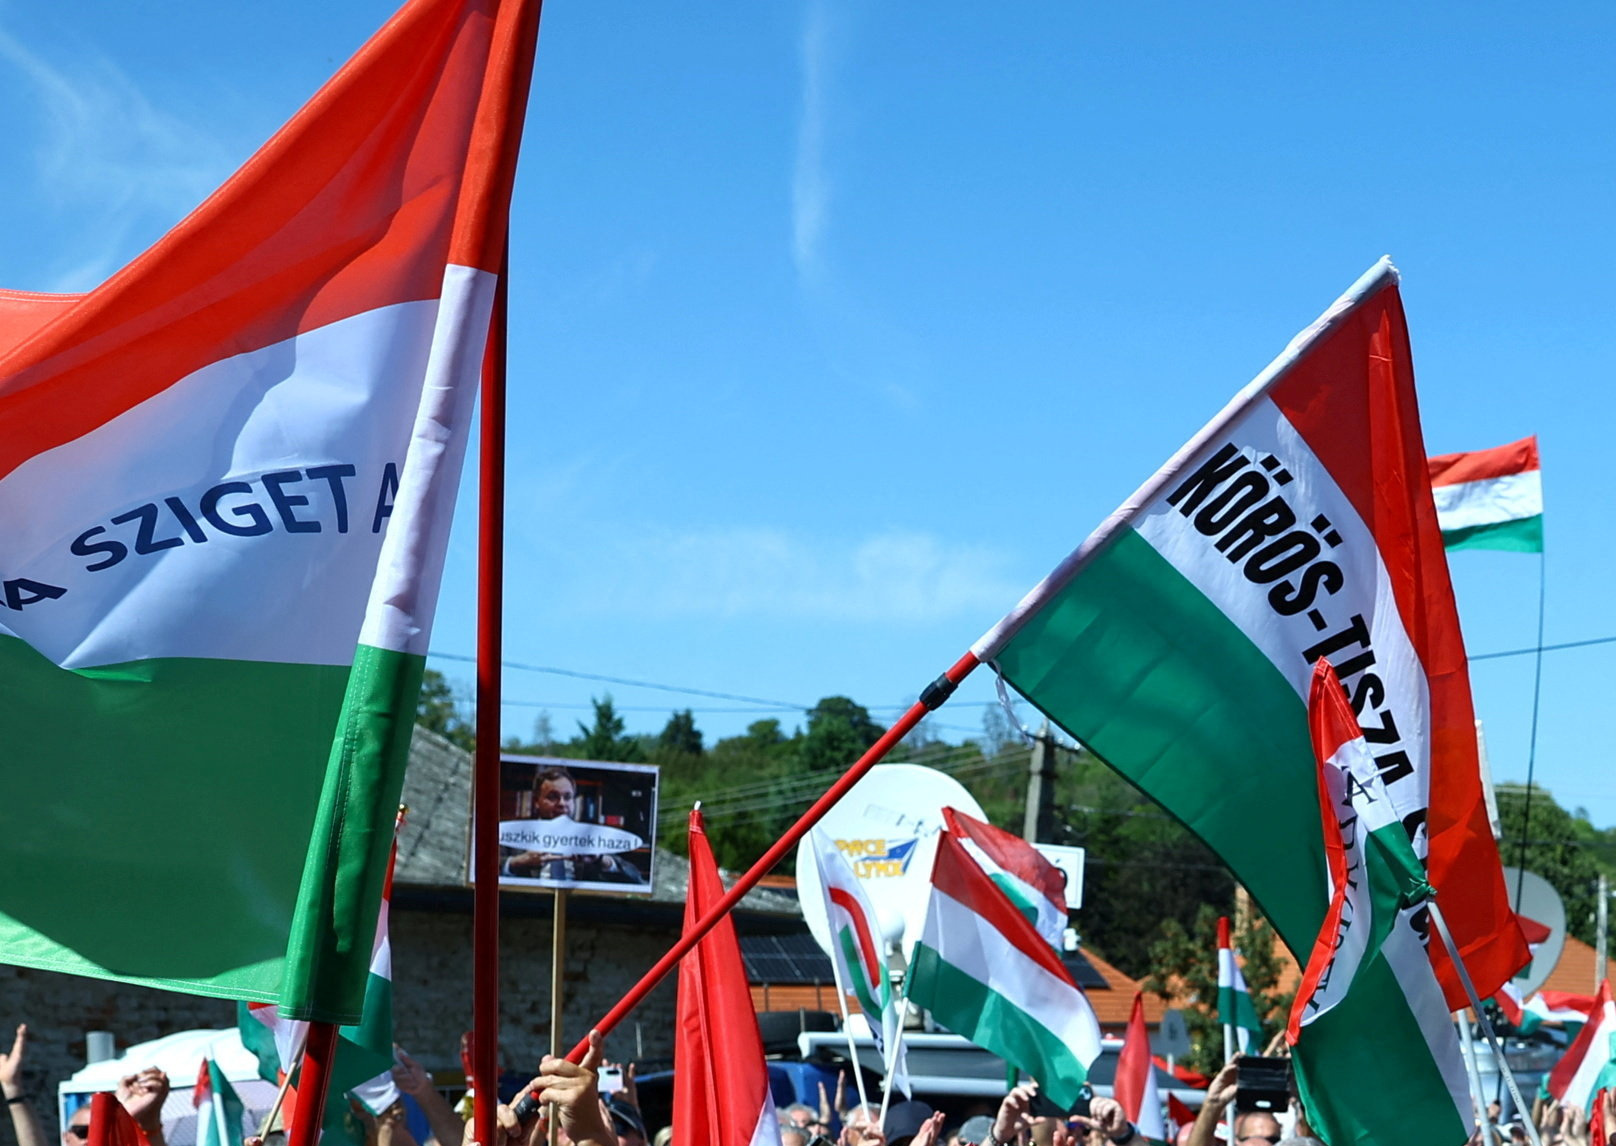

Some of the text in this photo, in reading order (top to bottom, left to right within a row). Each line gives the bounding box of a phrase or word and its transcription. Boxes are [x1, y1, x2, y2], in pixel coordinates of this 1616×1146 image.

[70, 464, 356, 572] SZIGET
[543, 833, 596, 848] gyertek
[598, 835, 631, 851] haza
